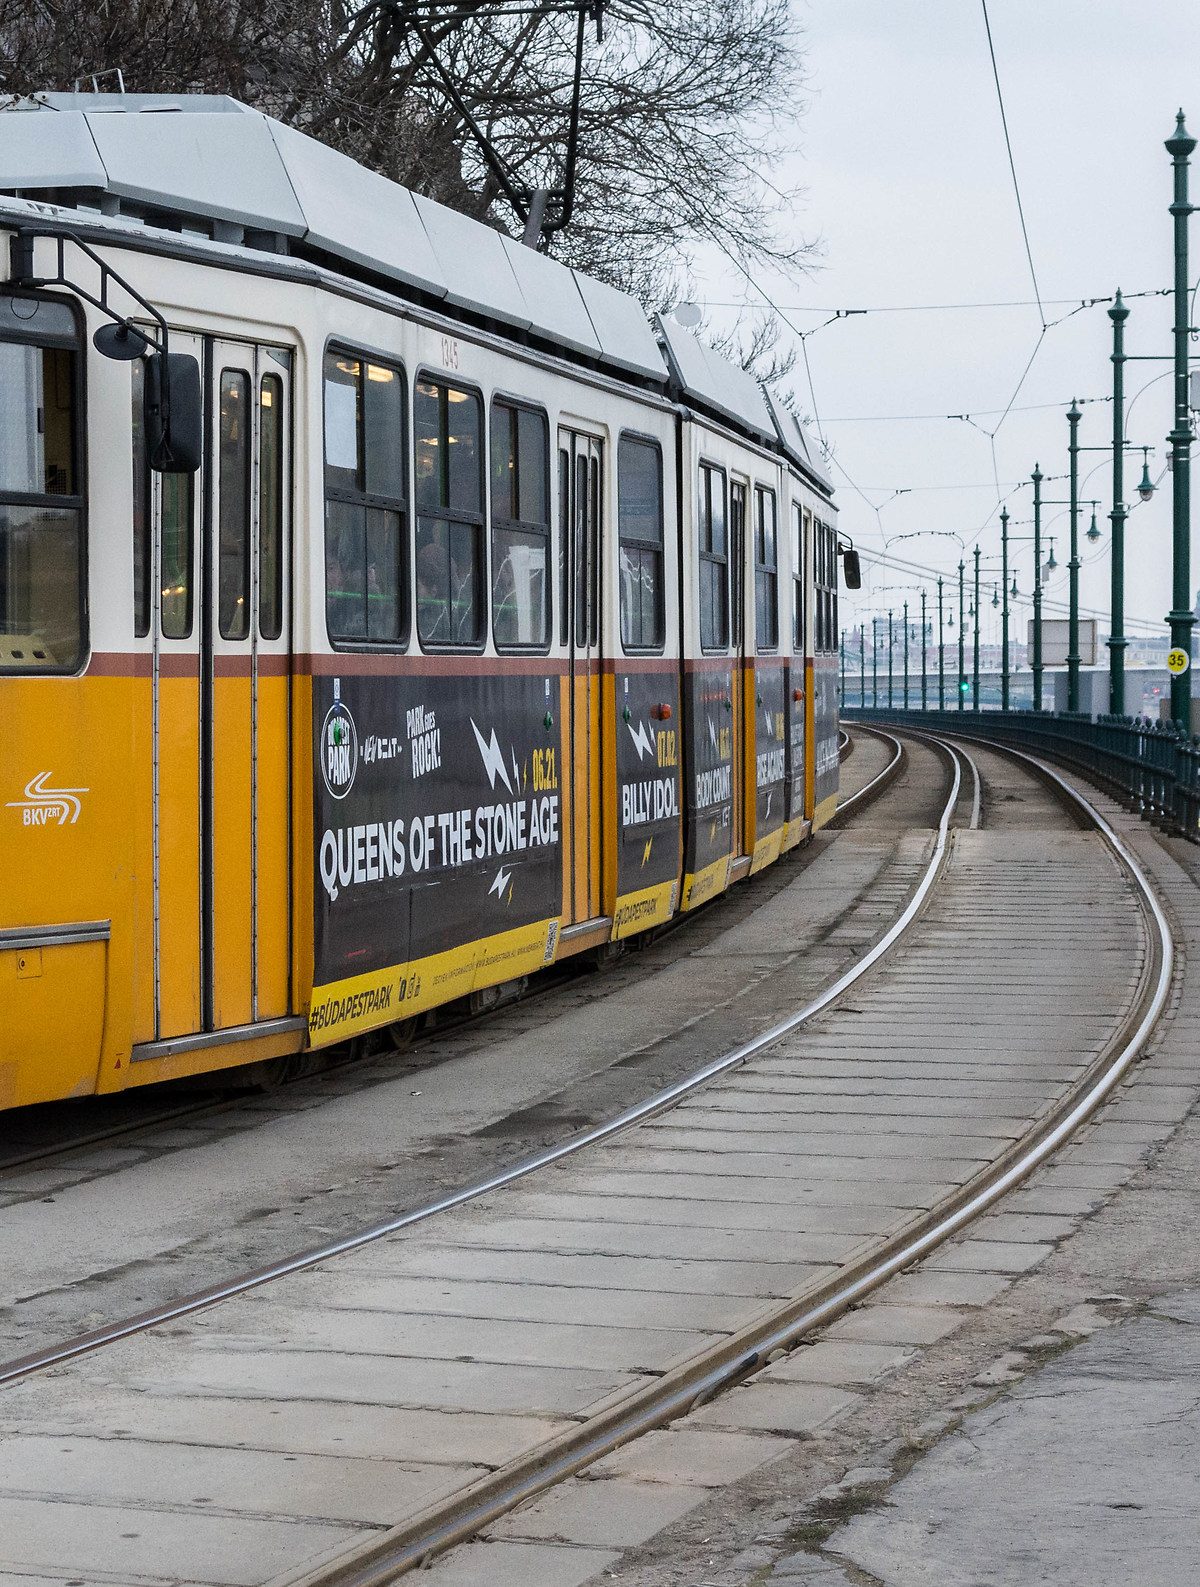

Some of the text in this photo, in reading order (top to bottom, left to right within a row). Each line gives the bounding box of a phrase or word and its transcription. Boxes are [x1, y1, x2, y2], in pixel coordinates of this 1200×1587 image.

[441, 337, 458, 370] 1345
[1169, 654, 1184, 667] 35
[406, 704, 425, 739] PARK
[328, 745, 351, 786] PARK
[411, 728, 441, 779] ROCK!
[532, 747, 558, 792] 06.21.
[622, 780, 652, 826] BILLY
[653, 777, 679, 821] IDOL
[319, 795, 559, 902] QUEENS OF THE STONE AGE
